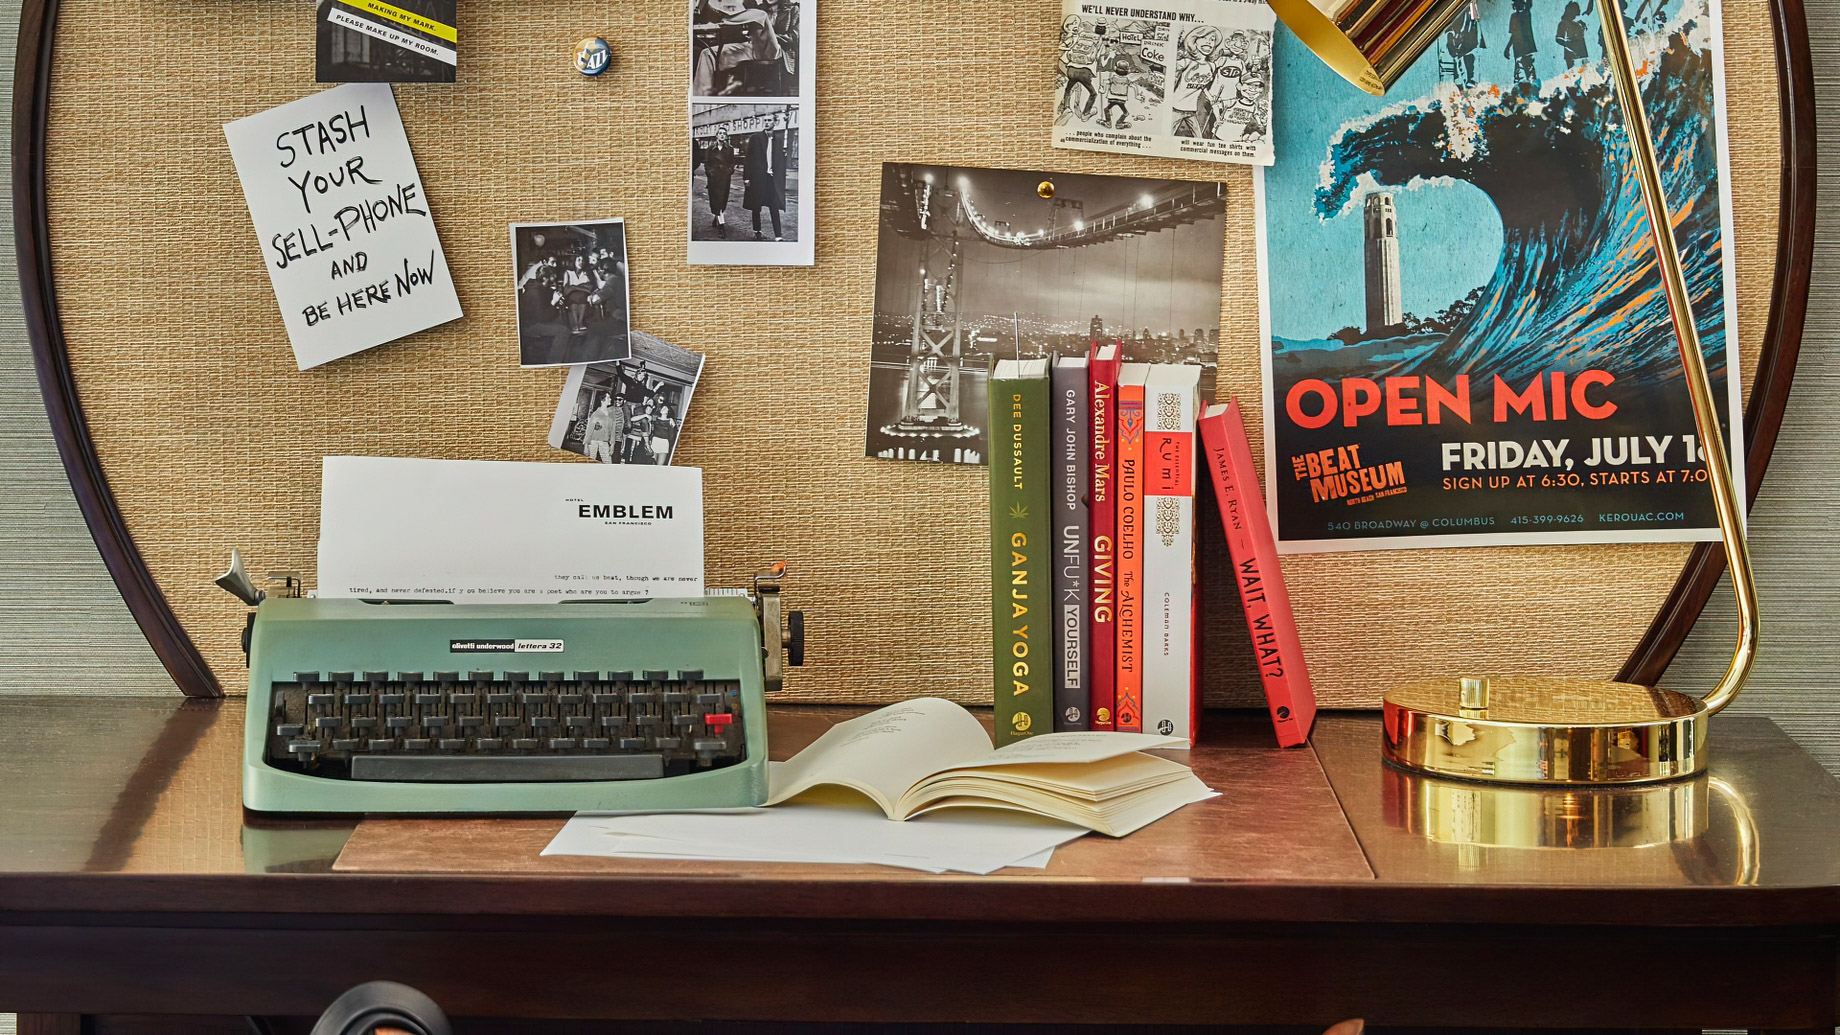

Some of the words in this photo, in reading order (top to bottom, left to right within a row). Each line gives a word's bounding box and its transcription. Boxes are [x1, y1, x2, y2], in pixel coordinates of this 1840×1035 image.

[367, 2, 398, 17] MAKING
[399, 13, 411, 21] MY
[412, 19, 437, 31] MARK.
[1081, 4, 1103, 15] WE'LL
[1105, 6, 1128, 17] NEVER
[1130, 8, 1177, 21] UNDERSTAND
[1178, 12, 1204, 24] WHY...
[336, 14, 365, 29] PLEASE
[366, 25, 388, 37] MAKE
[401, 37, 414, 46] MY
[414, 42, 439, 55] ROOM.
[1141, 47, 1165, 61] Coke
[1222, 68, 1240, 77] STP
[276, 105, 370, 168] STASH
[1065, 136, 1108, 145] commercialization
[1116, 140, 1141, 149] everything
[1105, 132, 1126, 140] complain
[288, 155, 383, 214] YOUR
[272, 183, 426, 269] SELL-PHONE
[331, 251, 367, 280] AND
[302, 301, 331, 326] BE
[336, 280, 391, 315] HERE
[394, 249, 435, 298] NOW
[1012, 394, 1022, 418] DEE
[1065, 389, 1076, 424] GARY
[1285, 374, 1471, 430] OPEN
[1493, 369, 1618, 423] MIC
[1094, 380, 1110, 460] Alexandre
[1013, 424, 1023, 490] DUSSAULT
[1066, 428, 1076, 461] JOHN
[1291, 454, 1308, 481] THE
[1305, 444, 1360, 478] BEAT
[1441, 438, 1574, 471] FRIDAY,
[1584, 435, 1673, 467] JULY
[1066, 465, 1076, 511] BISHOP
[1094, 463, 1110, 502] Mars
[1122, 459, 1135, 501] PAULO
[1224, 485, 1236, 497] E.
[1309, 461, 1406, 503] MUSEUM
[1442, 476, 1482, 490] SIGN
[1489, 475, 1510, 489] UP
[1516, 474, 1536, 488] AT
[1541, 473, 1585, 487] 6:30,
[1589, 471, 1650, 485] STARTS
[1656, 470, 1673, 484] AT
[578, 504, 673, 519] EMBLEM
[1327, 521, 1351, 531] 540
[1354, 519, 1417, 530] BROADWAY
[1420, 520, 1429, 529] @
[1432, 516, 1495, 527] COLUMBUS
[1510, 514, 1584, 524] 415-399-9626
[1598, 511, 1684, 522] KEROUAC.COM
[1122, 506, 1135, 560] COELHO
[1011, 532, 1028, 620] GANJA
[1094, 535, 1113, 623] GIVING
[1123, 571, 1134, 588] The
[1239, 557, 1266, 609] WAIT,
[1066, 607, 1078, 687] YOURSELF
[1119, 590, 1134, 673] ALCHEMIST
[1252, 613, 1285, 679] WHAT?
[1012, 625, 1030, 696] YOGA
